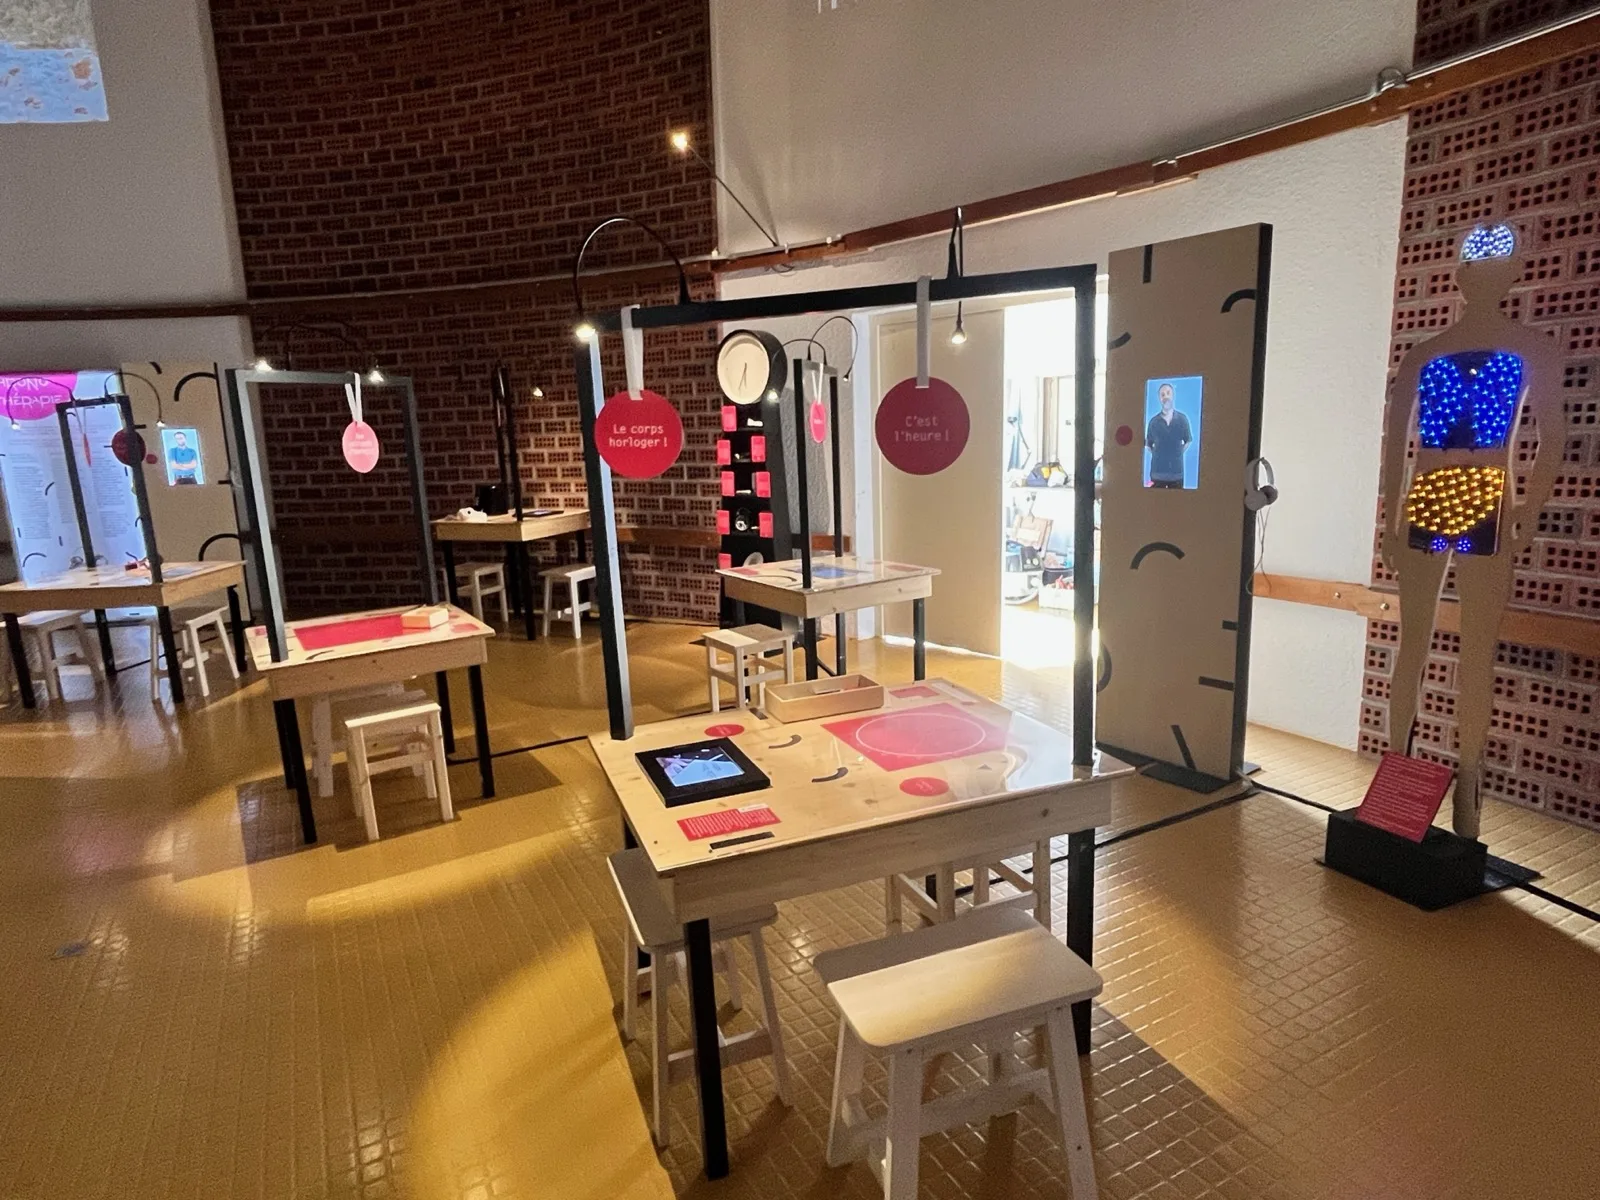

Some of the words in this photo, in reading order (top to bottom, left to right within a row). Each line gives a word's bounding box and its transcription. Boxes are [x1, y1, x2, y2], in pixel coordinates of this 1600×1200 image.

[905, 415, 939, 427] C'est
[613, 424, 627, 434] Le
[630, 425, 664, 435] corps
[608, 436, 660, 449] horloger
[663, 437, 667, 447] !
